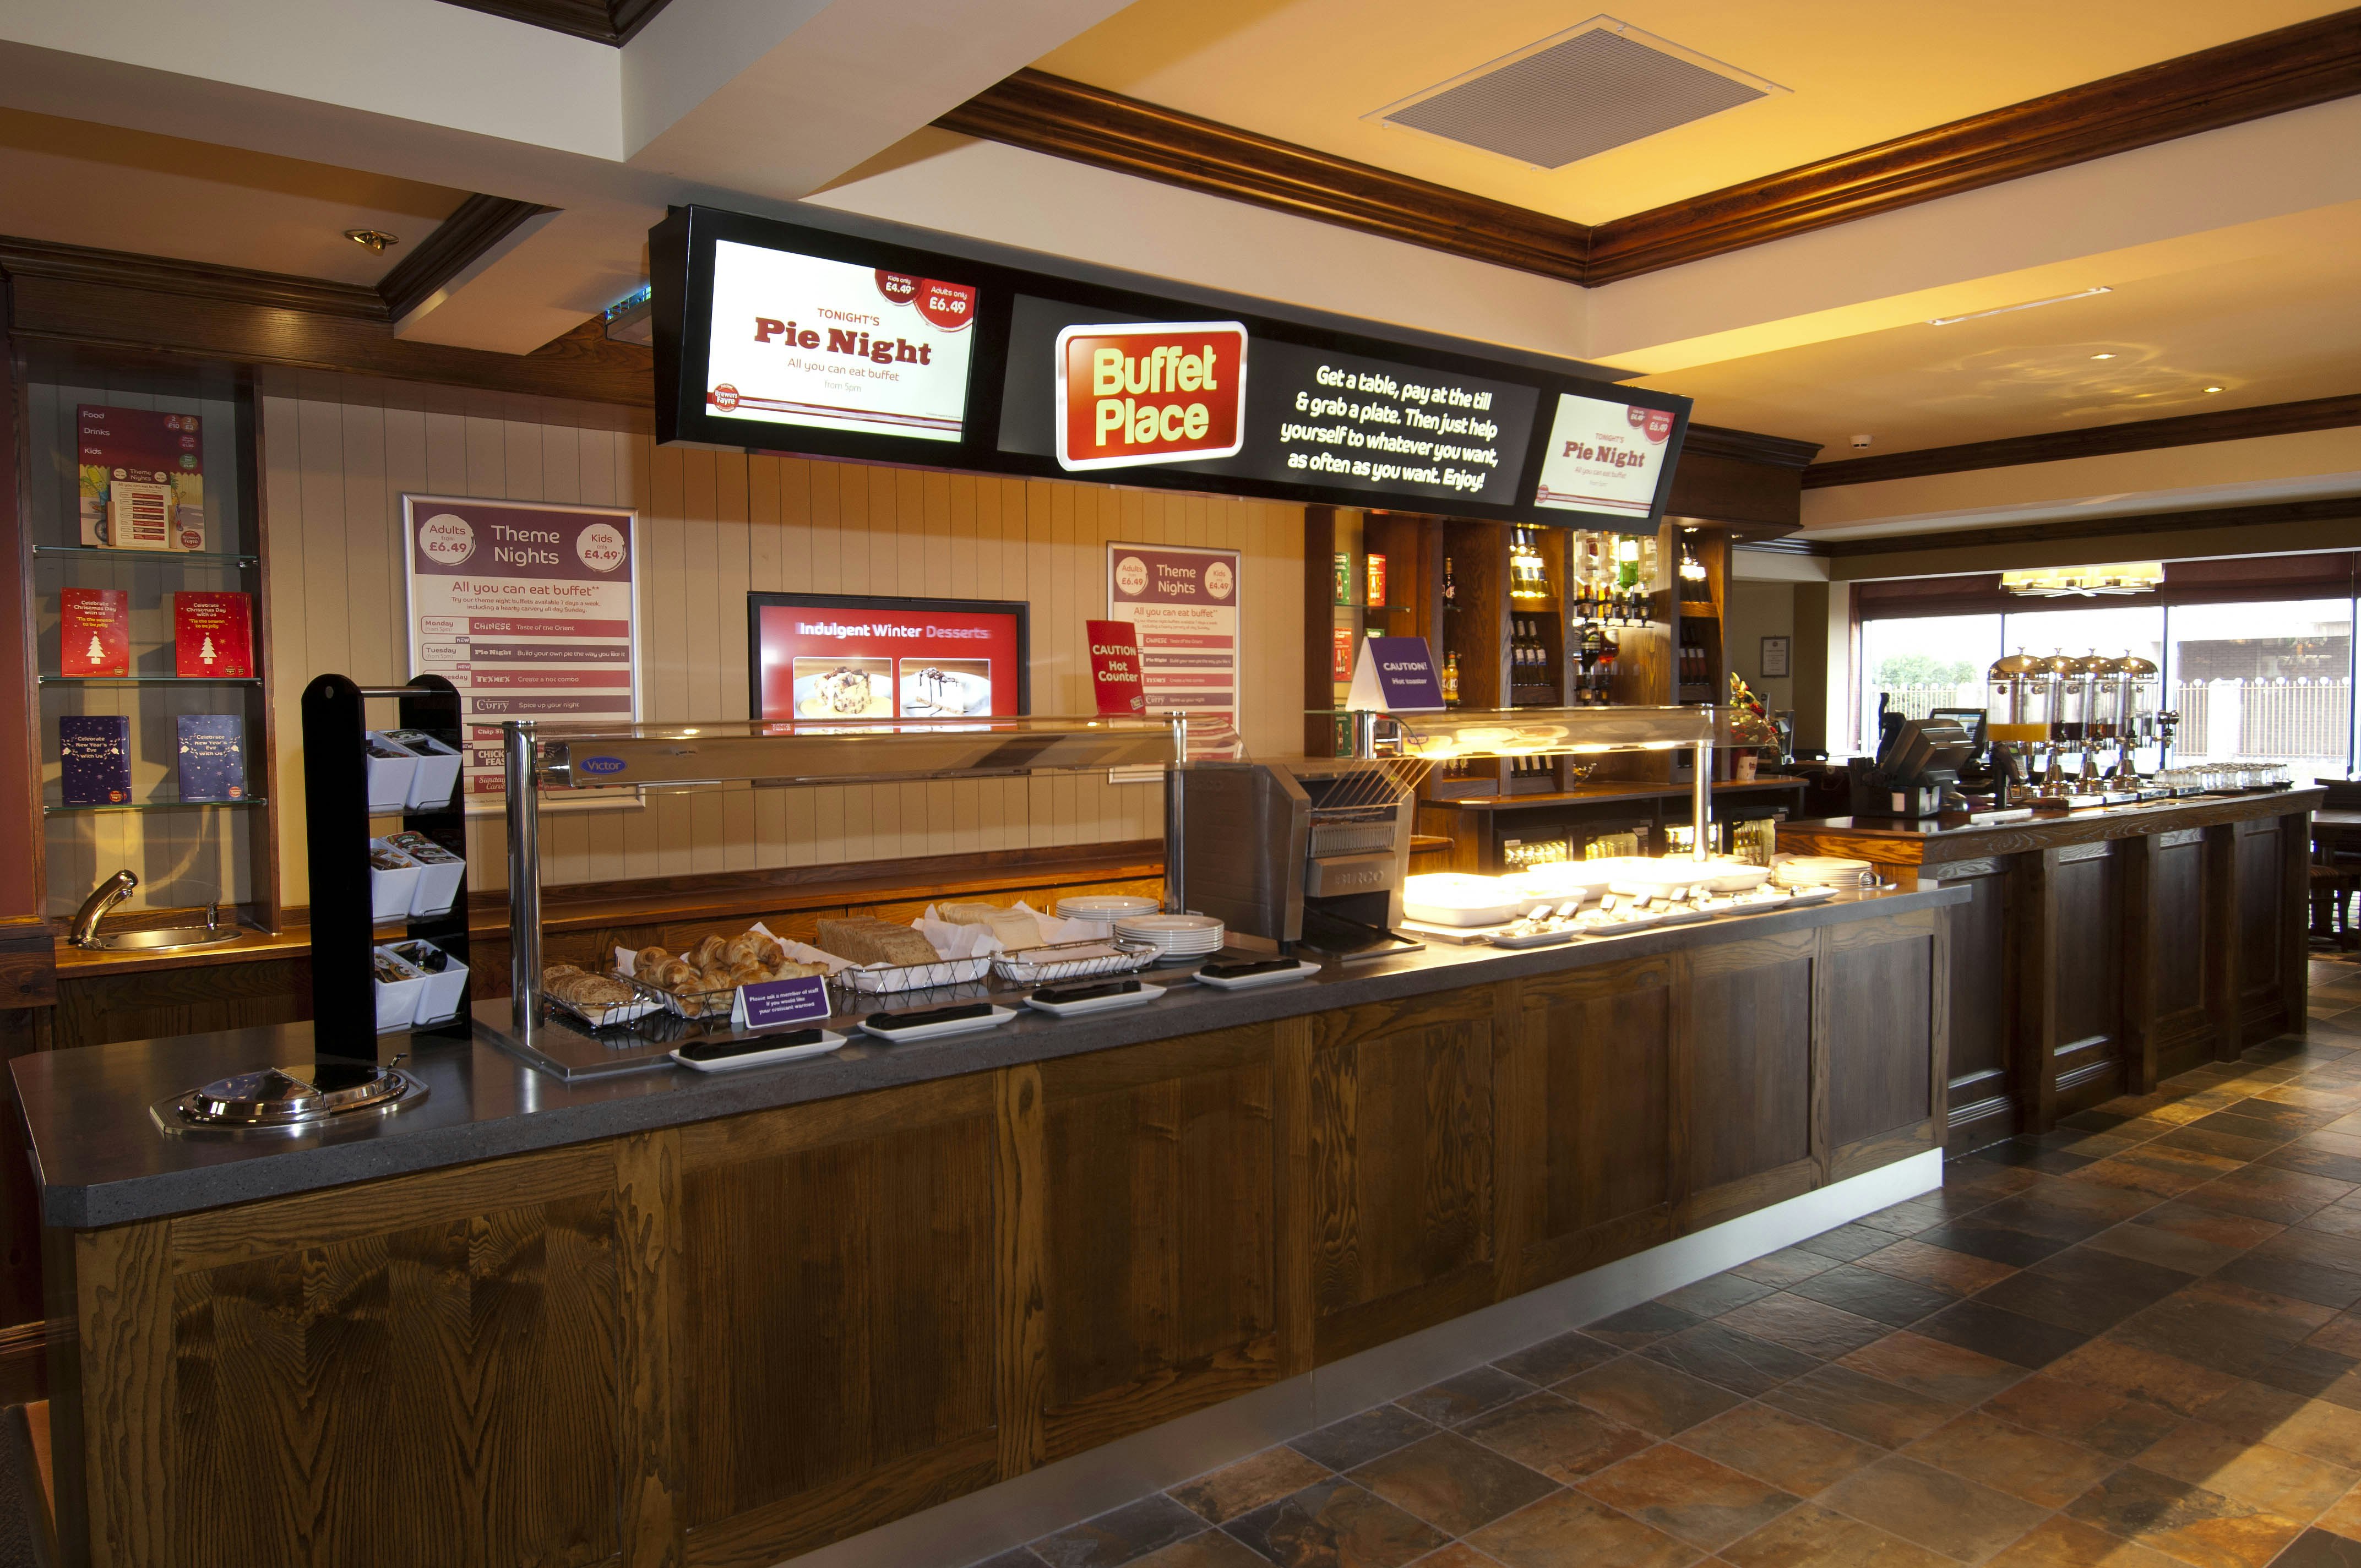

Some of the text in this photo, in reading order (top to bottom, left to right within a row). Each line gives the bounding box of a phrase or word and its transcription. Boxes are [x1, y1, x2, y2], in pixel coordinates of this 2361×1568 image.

[931, 286, 967, 300] Adults only
[929, 296, 966, 314] £6.49
[817, 308, 880, 326] TONIGHT'S
[754, 317, 932, 366] Pie Night
[787, 358, 899, 382] All you can eat buffet
[1093, 345, 1217, 396] Buffet
[825, 380, 861, 393] from 5pm
[1316, 365, 1493, 411] Get a table, pay at the till
[715, 390, 738, 399] Brewers
[717, 396, 735, 406] Fayre
[83, 411, 105, 419] Food
[1296, 391, 1499, 442] & grab a plate. Then just help
[1095, 398, 1210, 447] Place
[84, 427, 111, 436] Drinks
[1280, 422, 1499, 467] yourself to whatever you want,
[1563, 440, 1646, 468] Pie Night
[1287, 451, 1486, 493] as often as you want. Enjoy!
[429, 525, 466, 535] Adults
[491, 525, 561, 544] Theme
[591, 534, 613, 543] Kids
[429, 542, 467, 552] £6.49
[494, 546, 560, 567] Nights
[1122, 565, 1143, 573] Adults
[1156, 564, 1196, 578] Theme
[452, 581, 469, 592] All
[474, 585, 499, 595] you
[503, 585, 526, 595] can
[530, 586, 550, 595] eat
[1122, 578, 1144, 586] £6.49
[1158, 580, 1195, 596] Nights
[1134, 607, 1144, 616] All
[1146, 609, 1161, 617] you
[474, 623, 511, 631] CHINESE
[799, 622, 989, 639] Indulgent Winter Desserts
[1092, 644, 1136, 656] CAUTION
[1108, 661, 1128, 671] Hot
[1383, 662, 1428, 671] CAUTION!
[1098, 670, 1138, 682] Counter
[477, 699, 509, 712] Curry
[1145, 695, 1165, 705] Curry
[478, 750, 505, 759] CHICK
[586, 760, 622, 771] Victor
